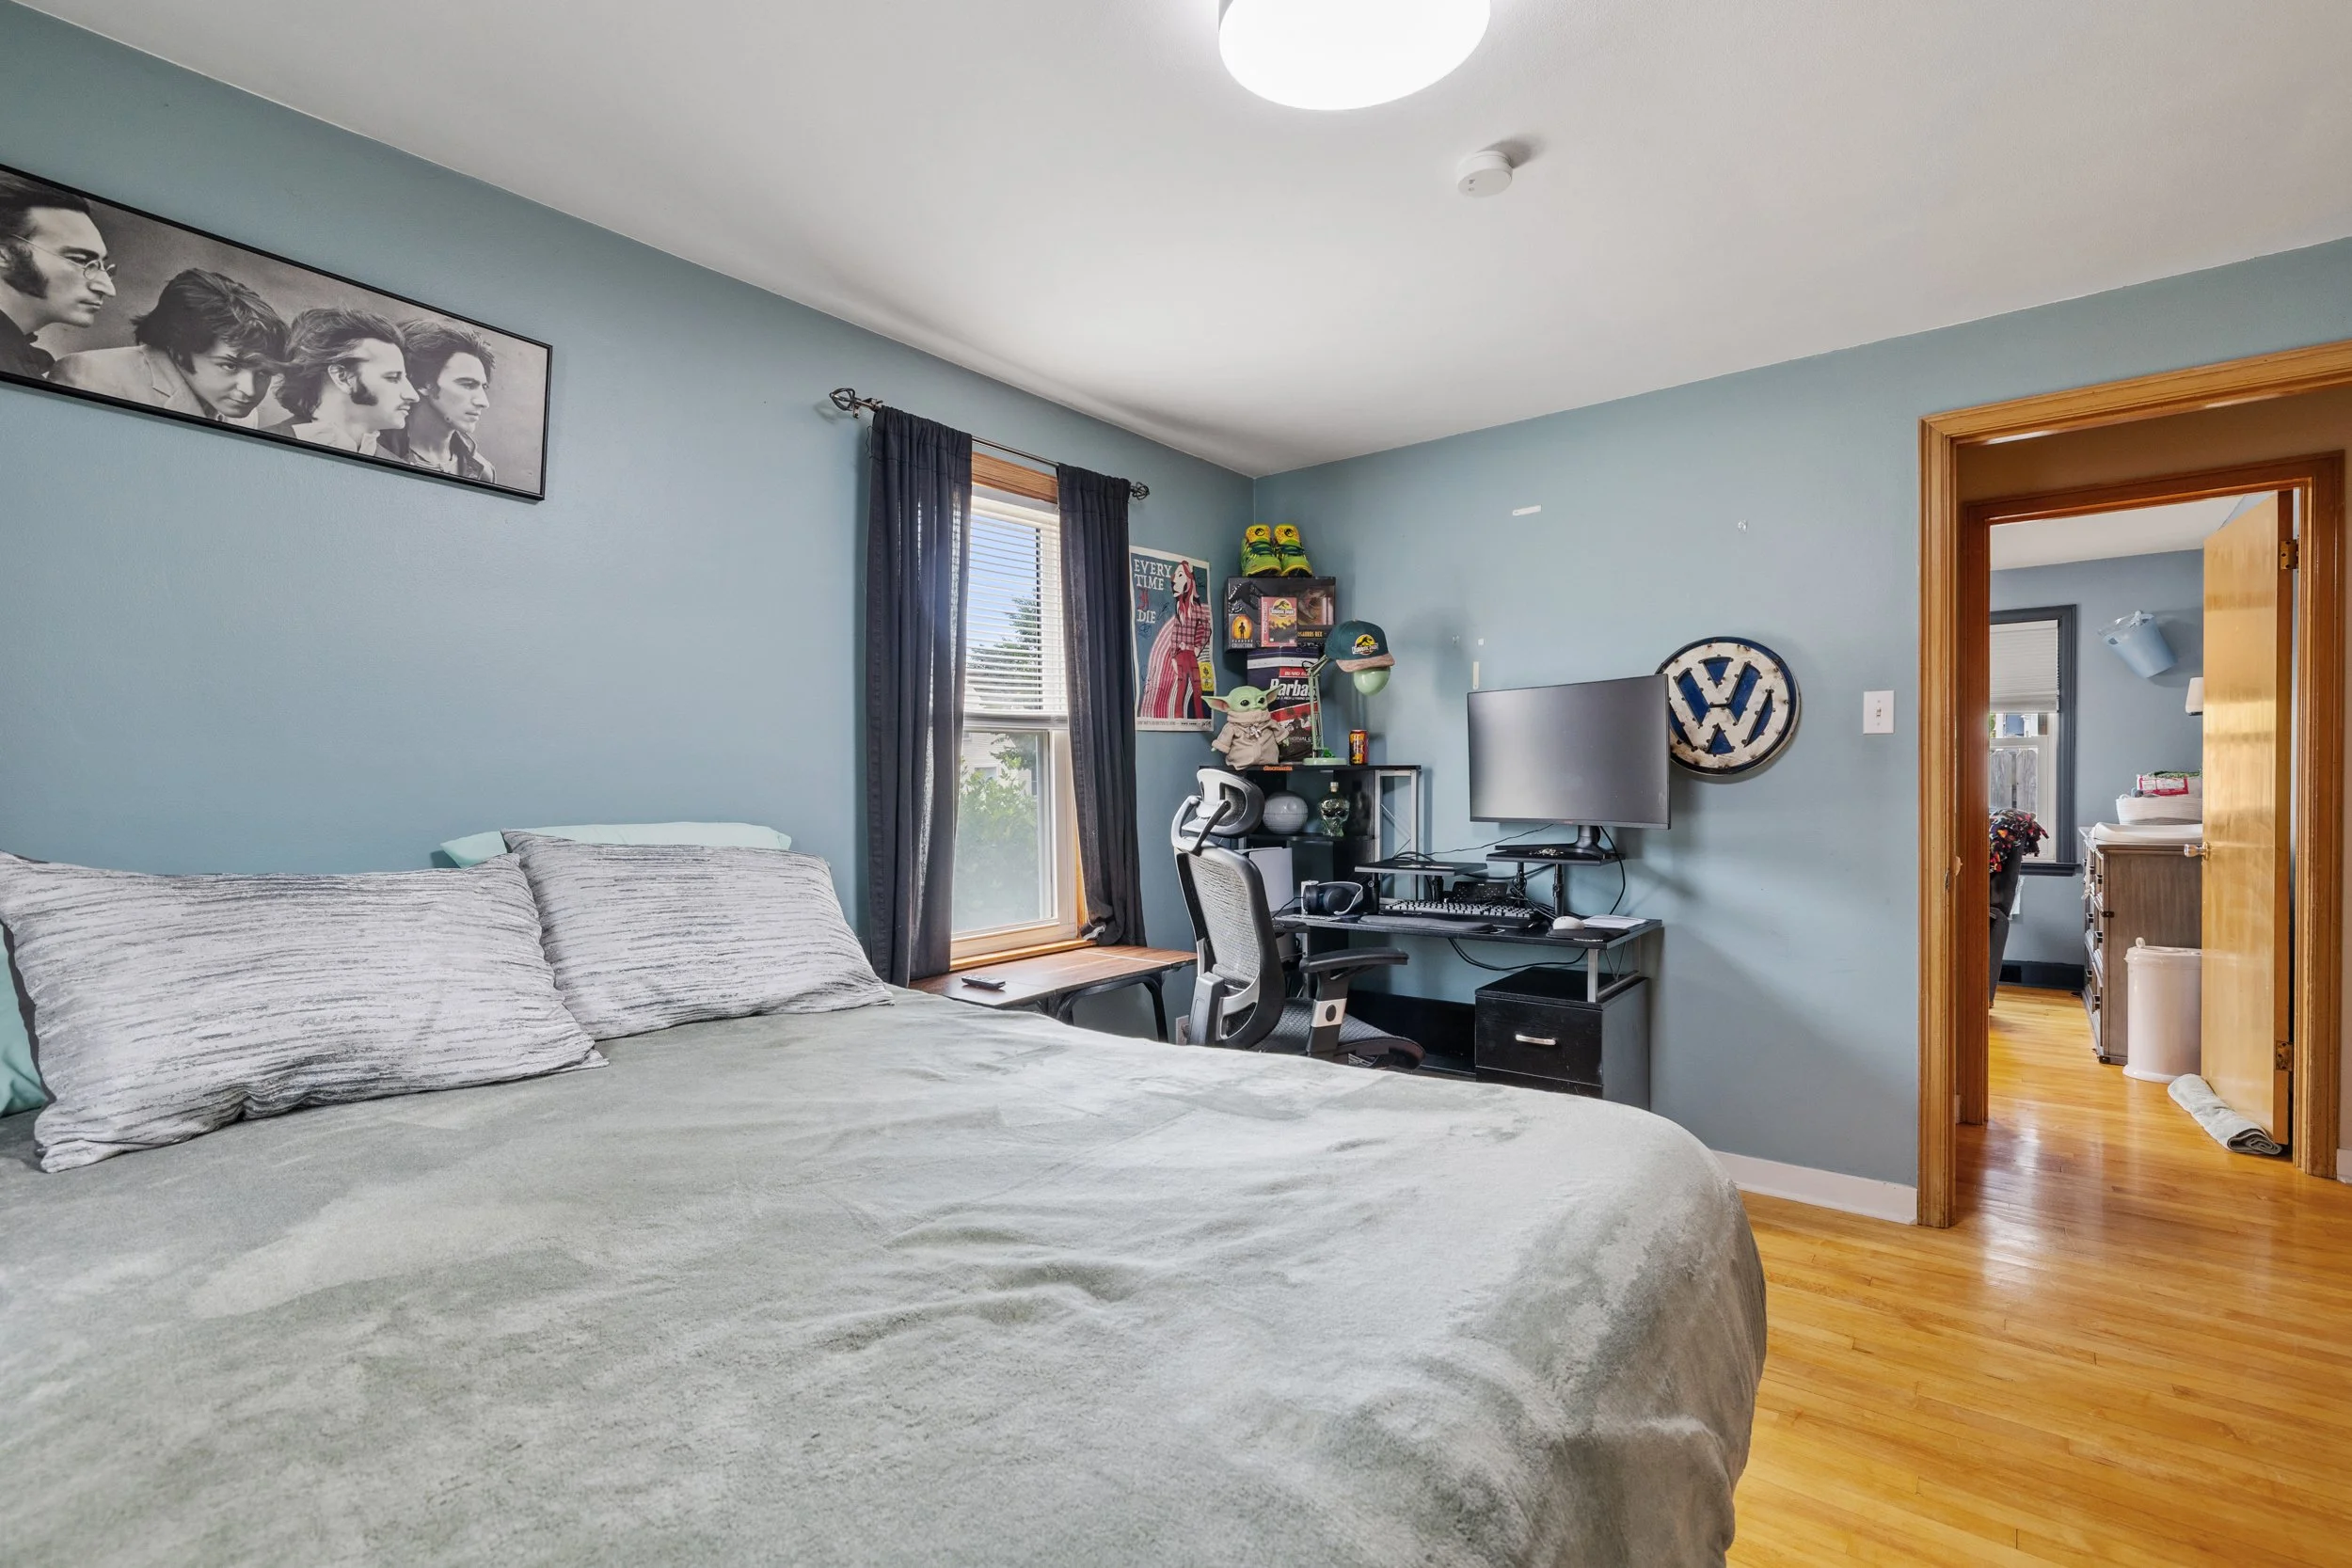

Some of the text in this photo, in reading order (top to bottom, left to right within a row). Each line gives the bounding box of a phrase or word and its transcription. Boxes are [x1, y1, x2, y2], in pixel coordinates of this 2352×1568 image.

[1134, 559, 1172, 578] EVERY
[1134, 573, 1165, 591] TIME
[1136, 609, 1157, 624] DIE
[1270, 678, 1316, 697] Barba
